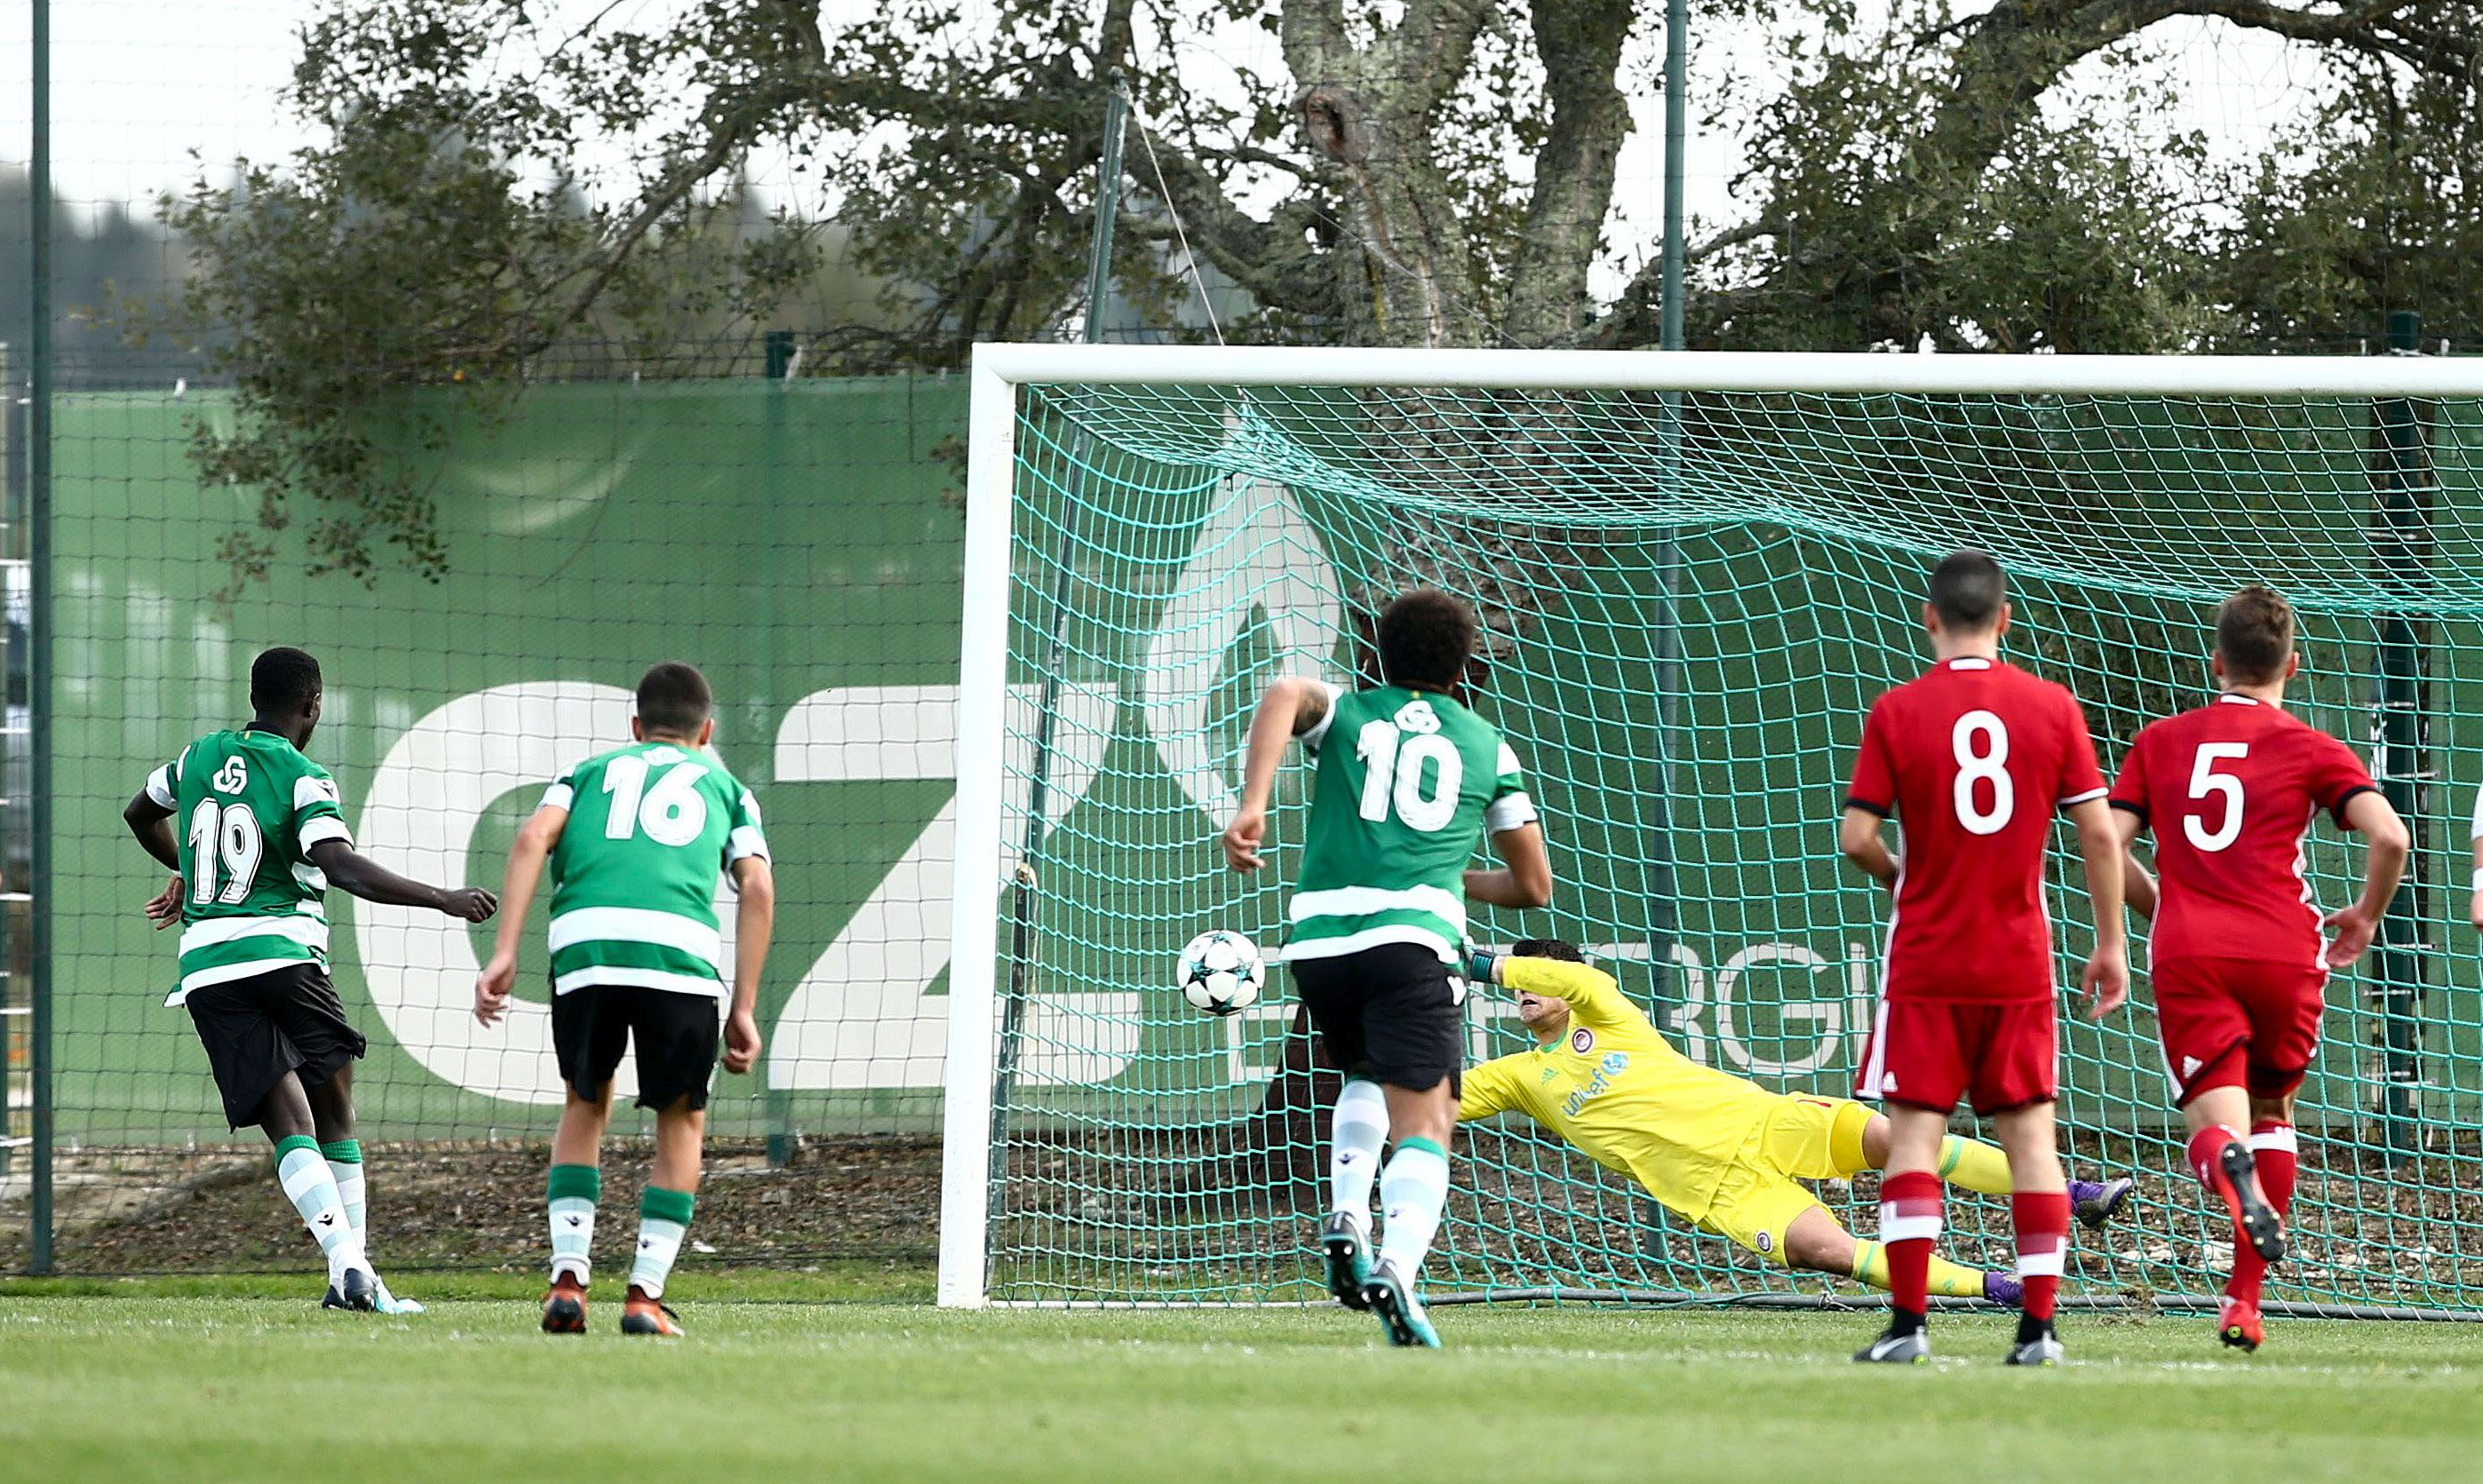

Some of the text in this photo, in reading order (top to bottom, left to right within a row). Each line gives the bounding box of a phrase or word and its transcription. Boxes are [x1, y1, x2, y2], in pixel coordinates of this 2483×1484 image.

[601, 755, 710, 847] 16
[1356, 719, 1464, 832] 10
[1951, 710, 2015, 835] 8
[2182, 742, 2250, 853] 5
[187, 797, 263, 905] 19
